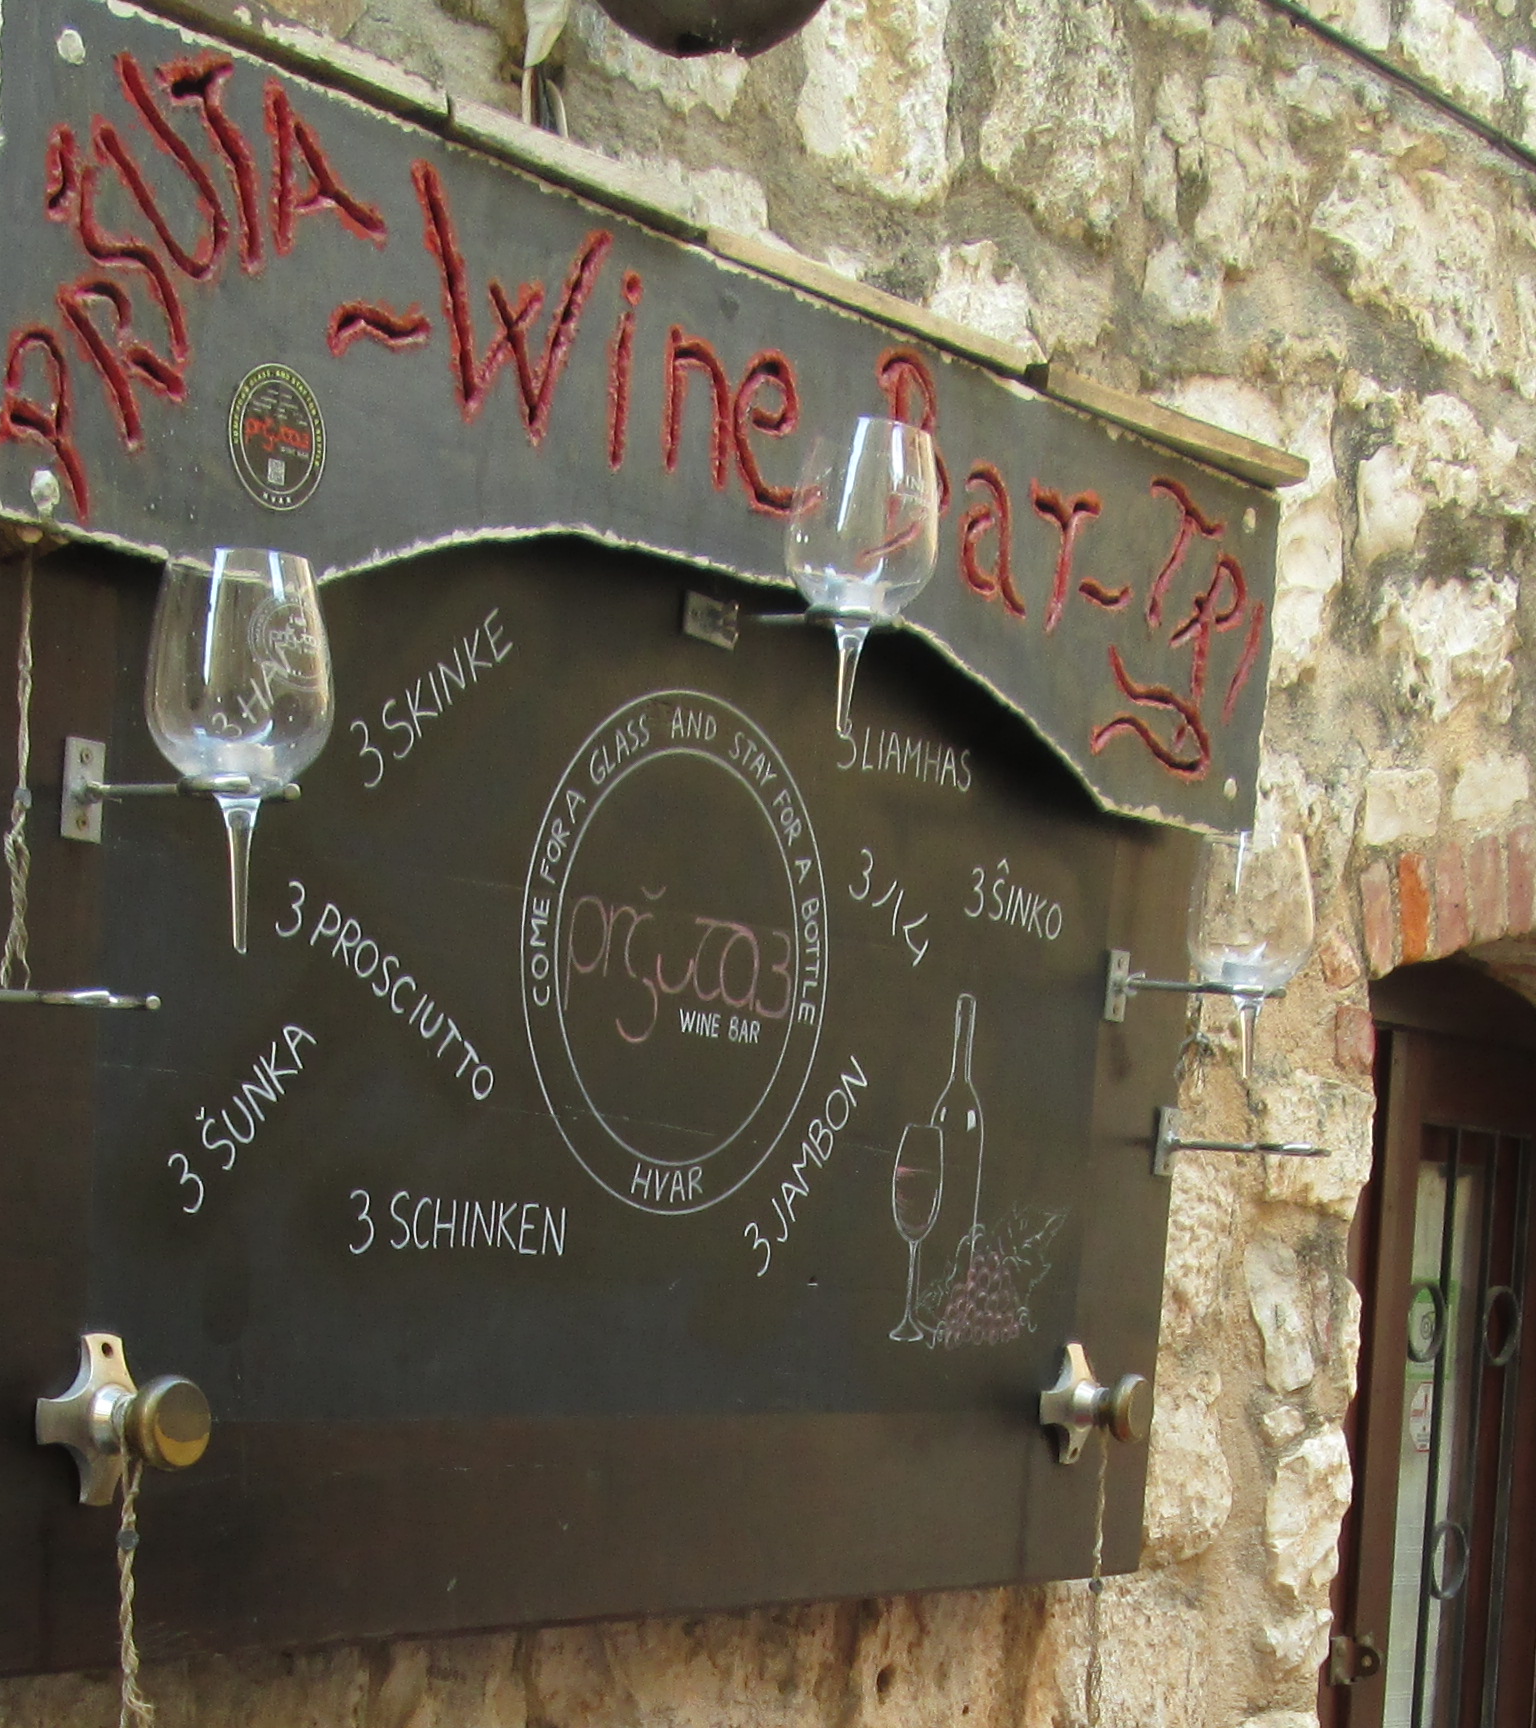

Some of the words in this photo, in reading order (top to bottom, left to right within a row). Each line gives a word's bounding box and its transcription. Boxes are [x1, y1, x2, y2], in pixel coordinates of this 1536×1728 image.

[349, 719, 385, 790] 3
[381, 607, 515, 760] SKINKE
[670, 706, 718, 742] AND
[588, 713, 651, 785] GLASS
[727, 731, 778, 787] STAY
[861, 726, 973, 792] LIAMHAS
[565, 789, 587, 825] A
[771, 788, 803, 847] FOR
[539, 817, 570, 885] FOR
[794, 858, 813, 885] A
[529, 896, 552, 1007] COME
[797, 897, 821, 1026] BOTTLE
[275, 880, 307, 938] 3
[309, 902, 495, 1101] PROSCIUTTO
[678, 1008, 721, 1039] WINE
[728, 1016, 762, 1044] BAR
[167, 1152, 206, 1214] 3
[195, 1024, 318, 1171] ŠUNKA
[630, 1162, 704, 1203] HVAR
[743, 1221, 772, 1279] 3
[771, 1054, 869, 1243] JAMBON
[348, 1189, 376, 1255] 3
[389, 1190, 566, 1257] SCHINKEN
